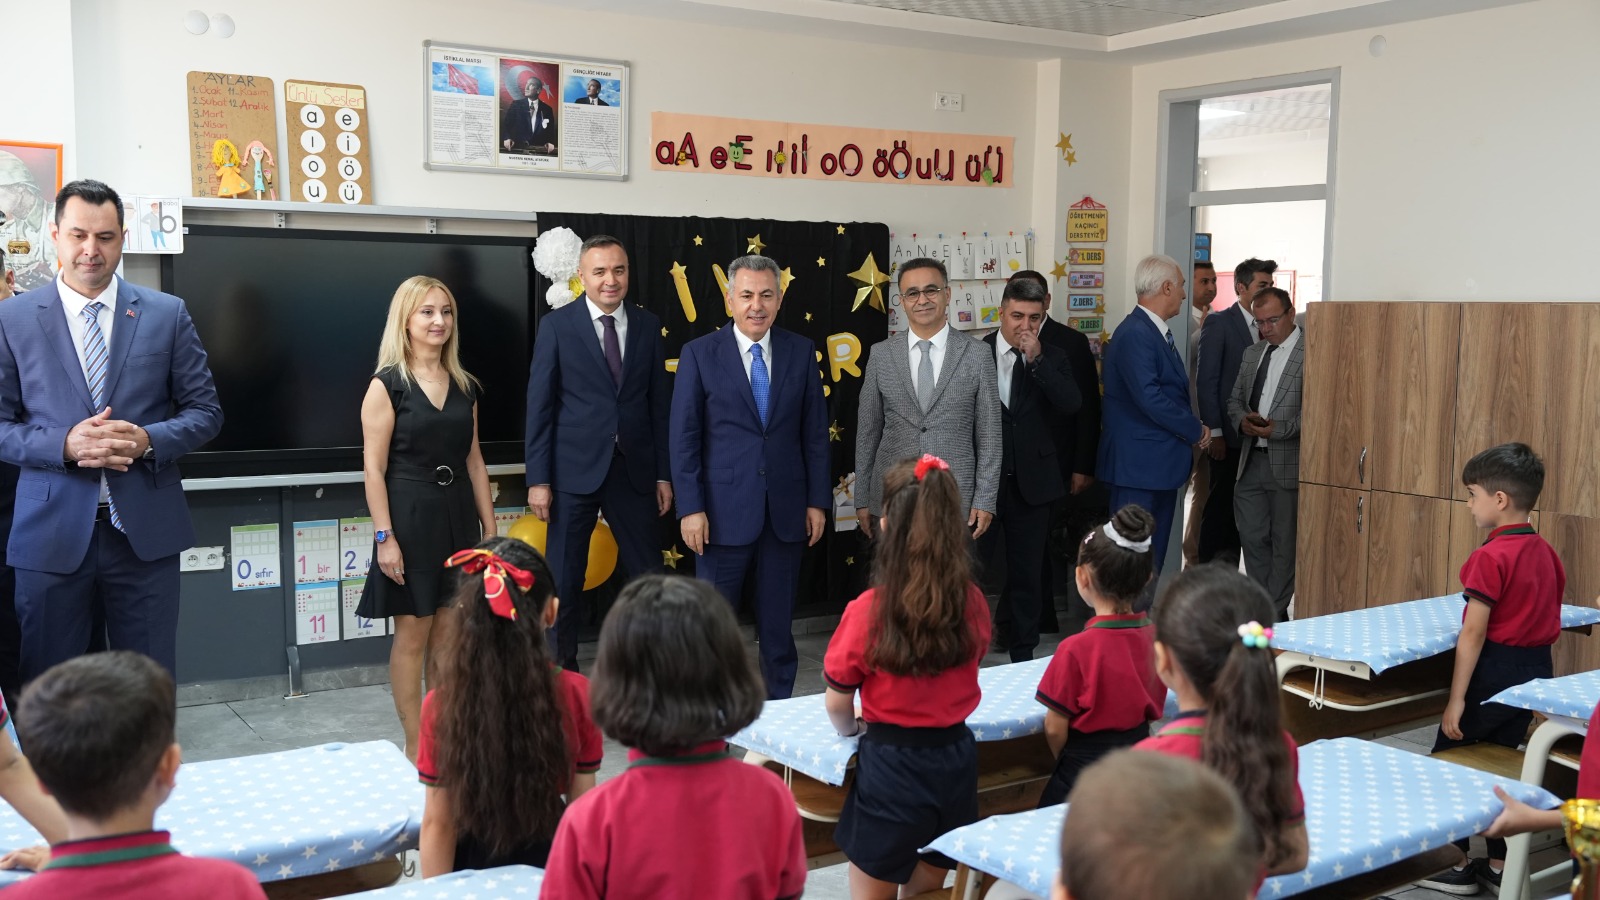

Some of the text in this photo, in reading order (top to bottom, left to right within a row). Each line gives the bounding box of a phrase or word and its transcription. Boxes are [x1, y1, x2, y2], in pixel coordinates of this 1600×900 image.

[203, 72, 257, 88] AYLAR
[306, 111, 352, 126] a e
[346, 135, 350, 152] i
[308, 160, 355, 176] o ö
[308, 184, 355, 201] u ü
[1069, 211, 1106, 220] ÖĞRETMENİM
[1074, 222, 1099, 230] KAÇINCI
[297, 555, 306, 575] 1
[344, 550, 357, 571] 2
[237, 559, 252, 580] 0
[309, 613, 325, 634] 11
